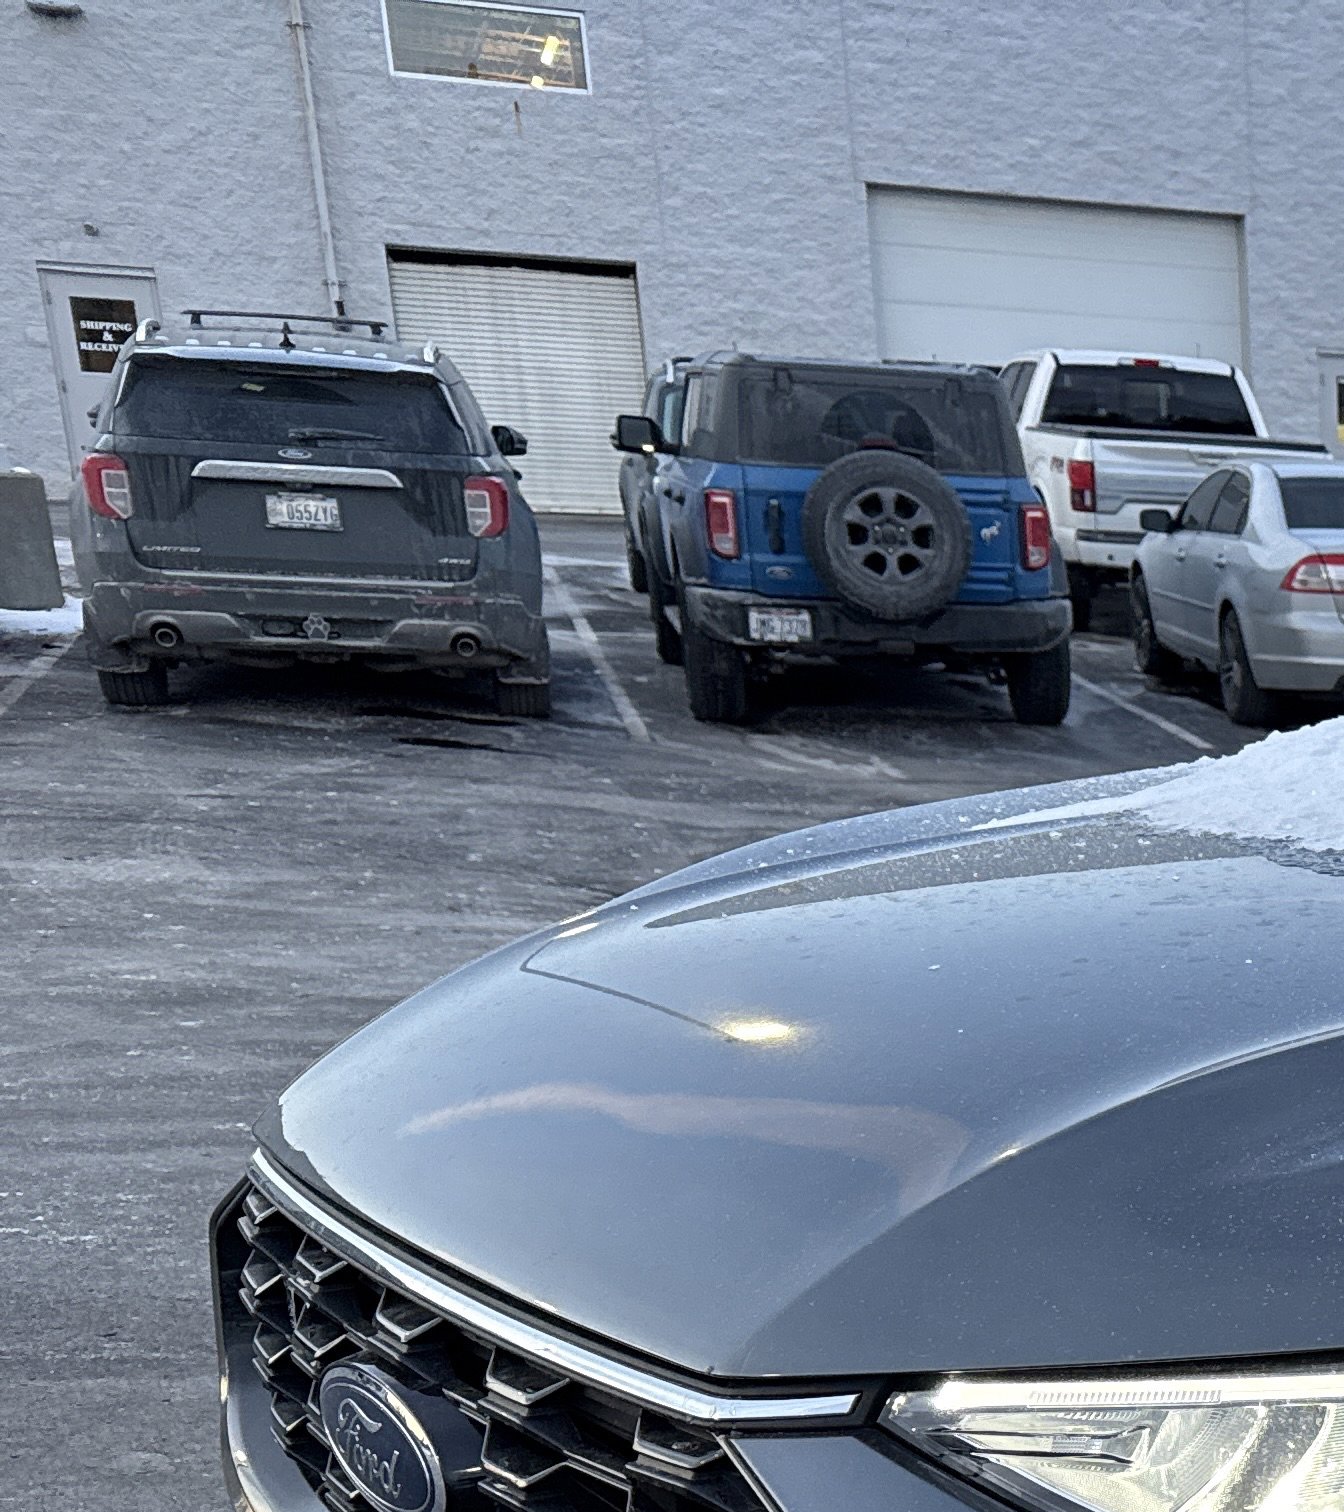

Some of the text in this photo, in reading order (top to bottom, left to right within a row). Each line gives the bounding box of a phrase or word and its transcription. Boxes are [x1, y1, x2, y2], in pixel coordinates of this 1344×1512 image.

[80, 320, 133, 331] SHIPPING
[102, 331, 113, 341] &
[80, 342, 121, 352] RECEIV
[336, 1397, 401, 1500] Ford
